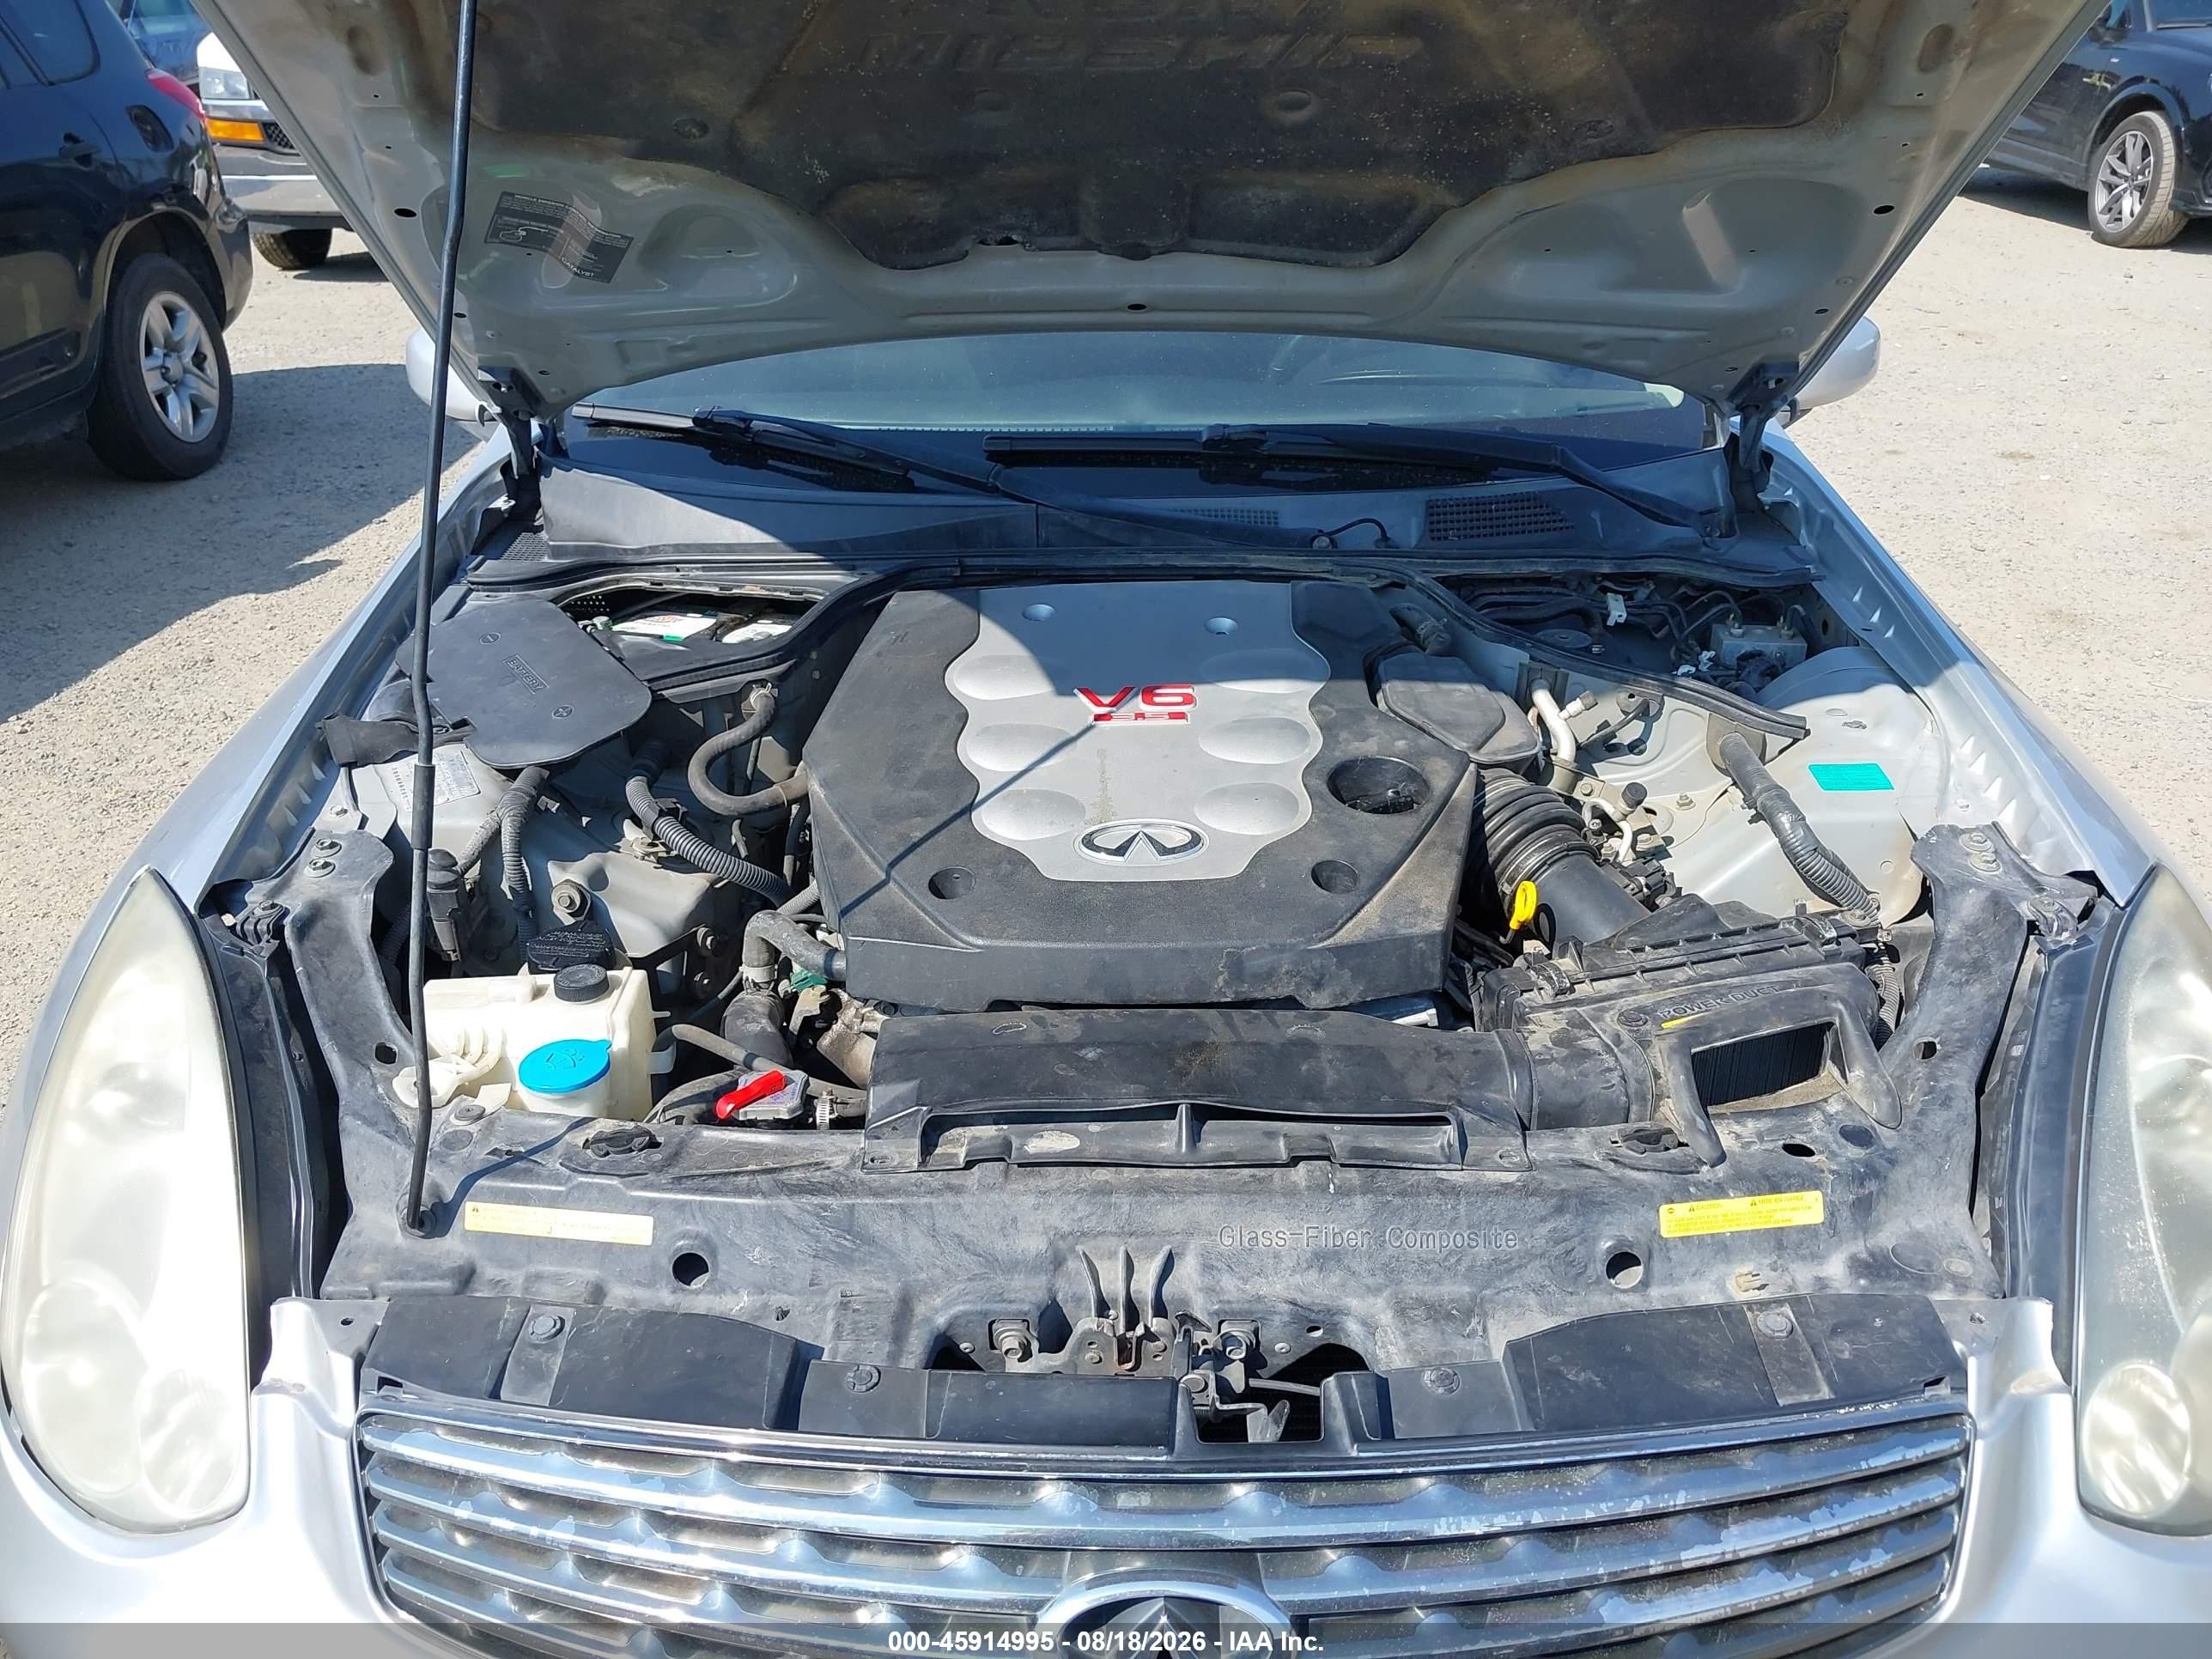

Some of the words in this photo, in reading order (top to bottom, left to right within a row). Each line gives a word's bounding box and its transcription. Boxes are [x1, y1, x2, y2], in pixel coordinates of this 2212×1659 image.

[561, 257, 596, 278] CATALYST
[507, 658, 544, 690] BATTERY
[1073, 683, 1199, 712] V6
[1658, 997, 1729, 1019] POWER
[1728, 985, 1780, 1003] DUCT
[1218, 1224, 1370, 1249] Glass-Fiber
[1386, 1224, 1519, 1254] Composite
